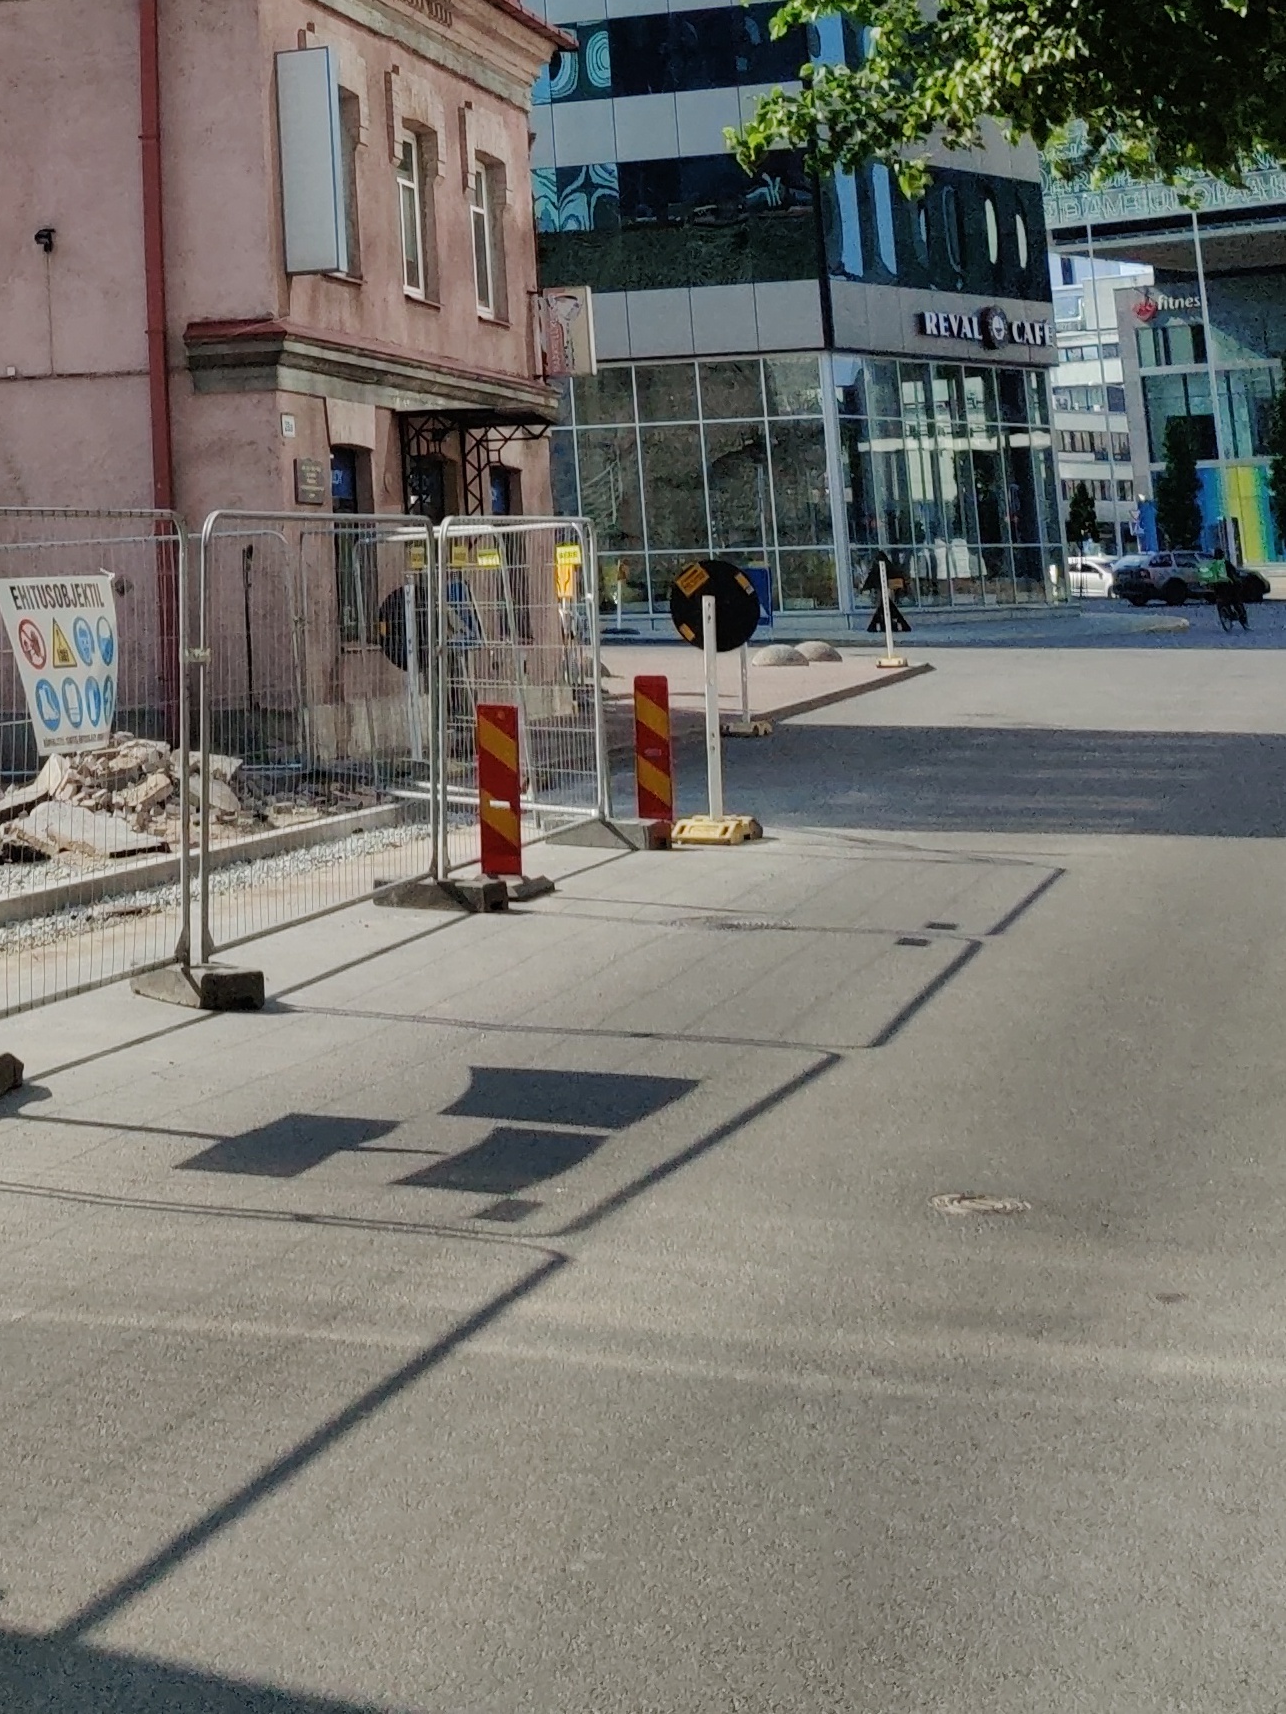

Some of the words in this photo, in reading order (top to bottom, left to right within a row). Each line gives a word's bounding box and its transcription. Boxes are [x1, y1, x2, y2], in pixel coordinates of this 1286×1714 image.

[1157, 294, 1204, 311] fitnes
[923, 311, 983, 340] REVAL
[9, 581, 105, 611] EHITUSOBJEKTIL
